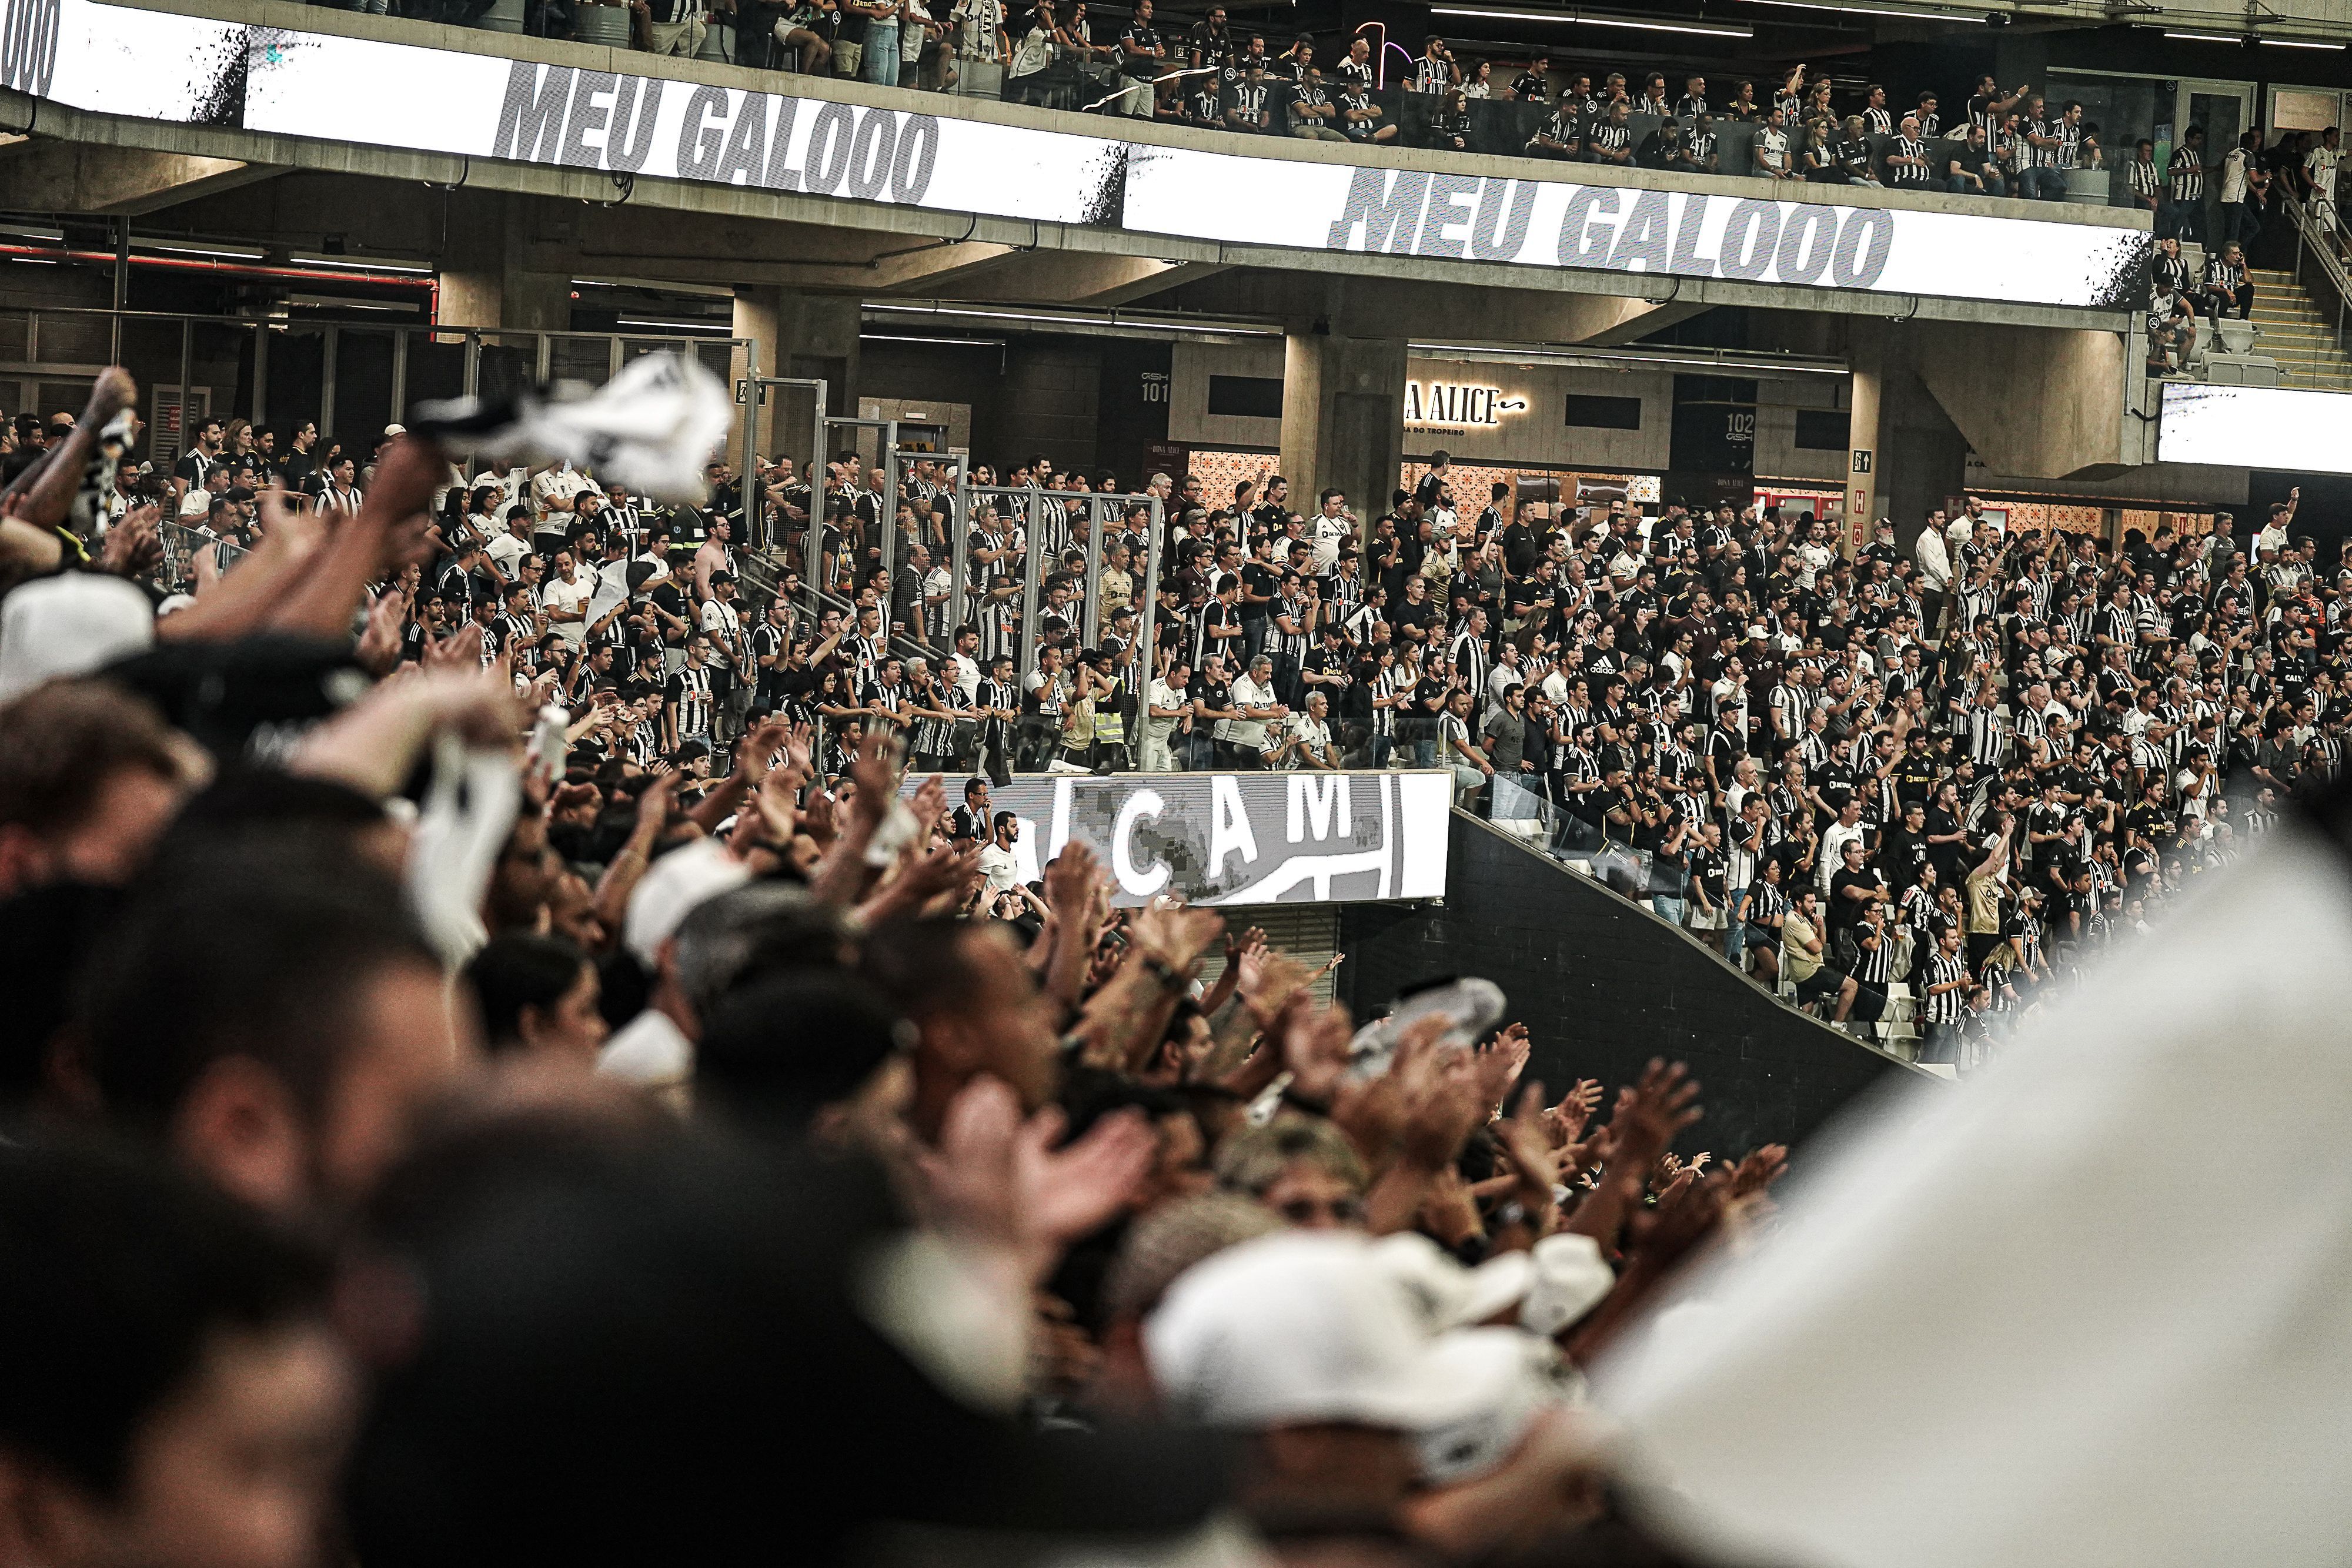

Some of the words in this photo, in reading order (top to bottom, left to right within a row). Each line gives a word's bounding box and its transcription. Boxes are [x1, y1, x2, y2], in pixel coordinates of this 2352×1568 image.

[492, 59, 664, 174] MEU
[677, 83, 939, 205] GALOOO
[1327, 166, 1540, 262] MEU
[1557, 185, 1895, 289] GALOOO
[1142, 383, 1168, 403] 101
[1429, 386, 1499, 423] ALICE
[1427, 428, 1465, 436] TROPEIRO
[1727, 414, 1754, 433] 102
[1856, 492, 1863, 511] H
[1590, 662, 1616, 674] adidas
